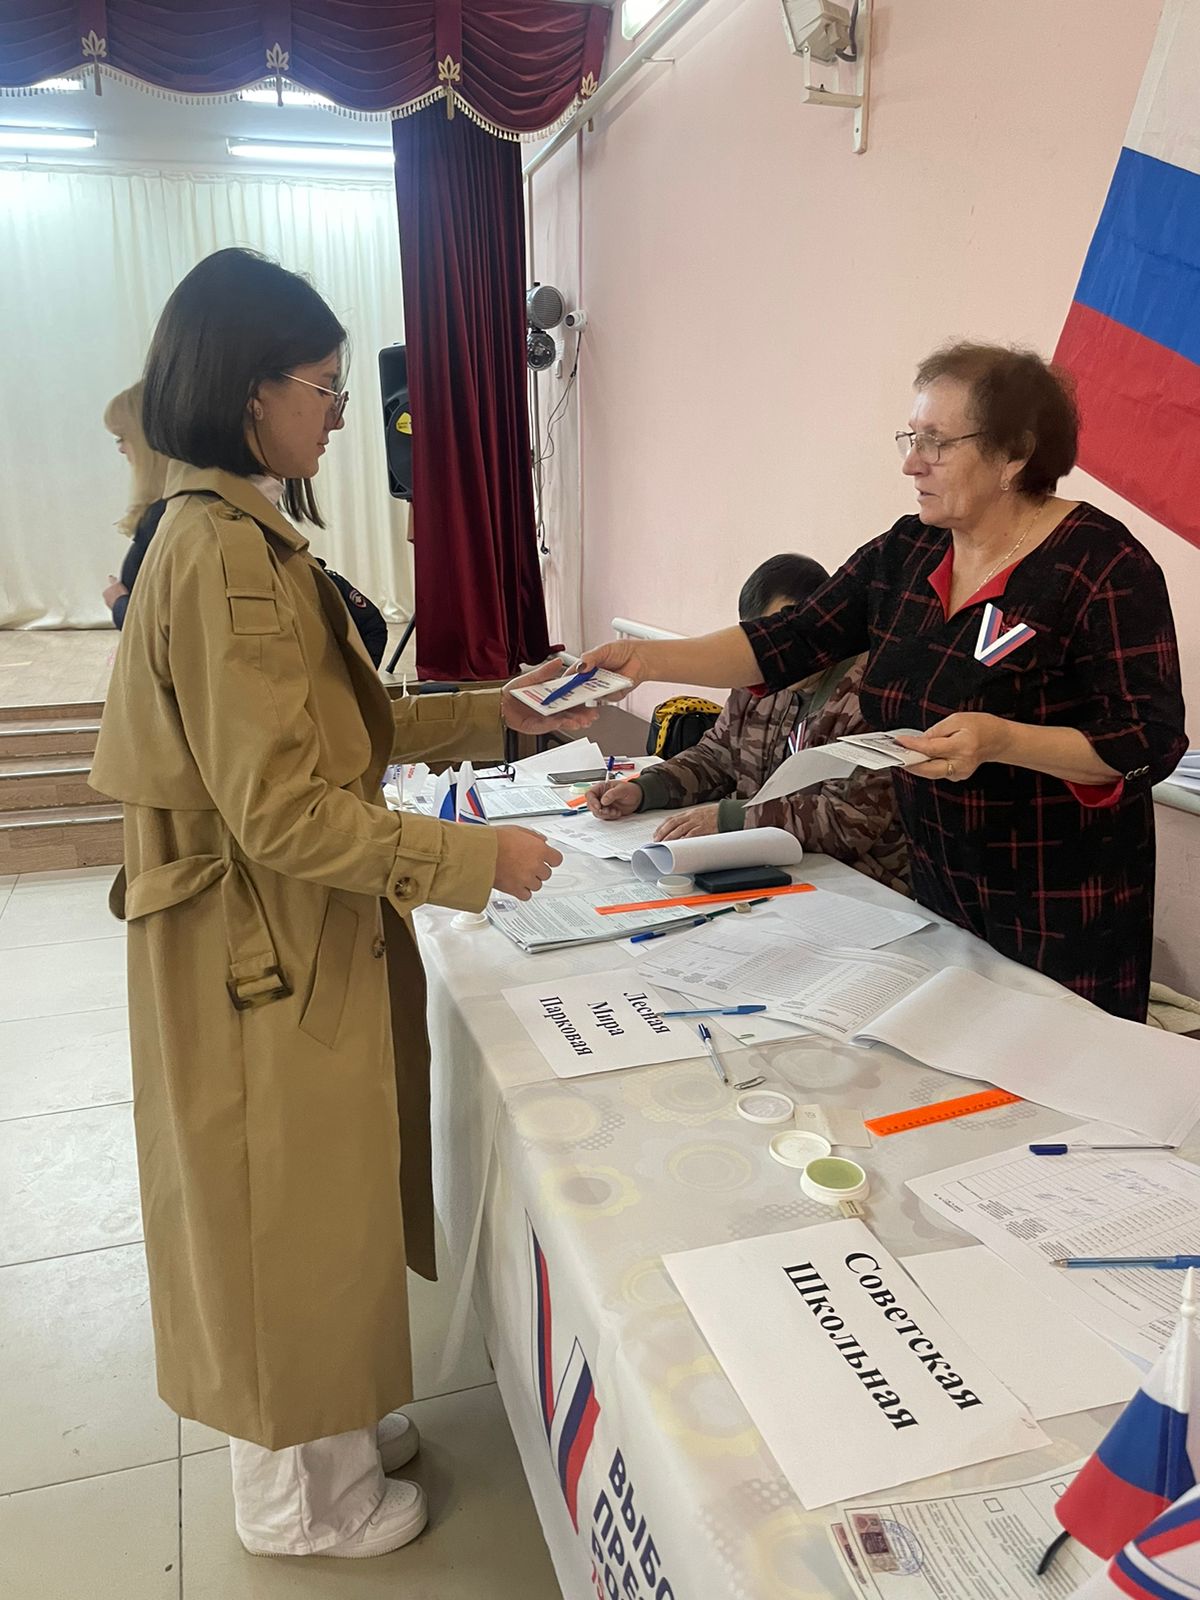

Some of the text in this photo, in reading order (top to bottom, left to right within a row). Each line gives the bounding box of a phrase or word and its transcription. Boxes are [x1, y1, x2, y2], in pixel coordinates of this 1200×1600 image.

[539, 996, 594, 1057] Парковая
[587, 1000, 625, 1037] Мира
[623, 991, 671, 1034] Лесная
[782, 1261, 919, 1431] Школьная
[844, 1252, 983, 1411] Советская
[591, 1526, 624, 1600] РО
[593, 1488, 644, 1600] ПРЕ
